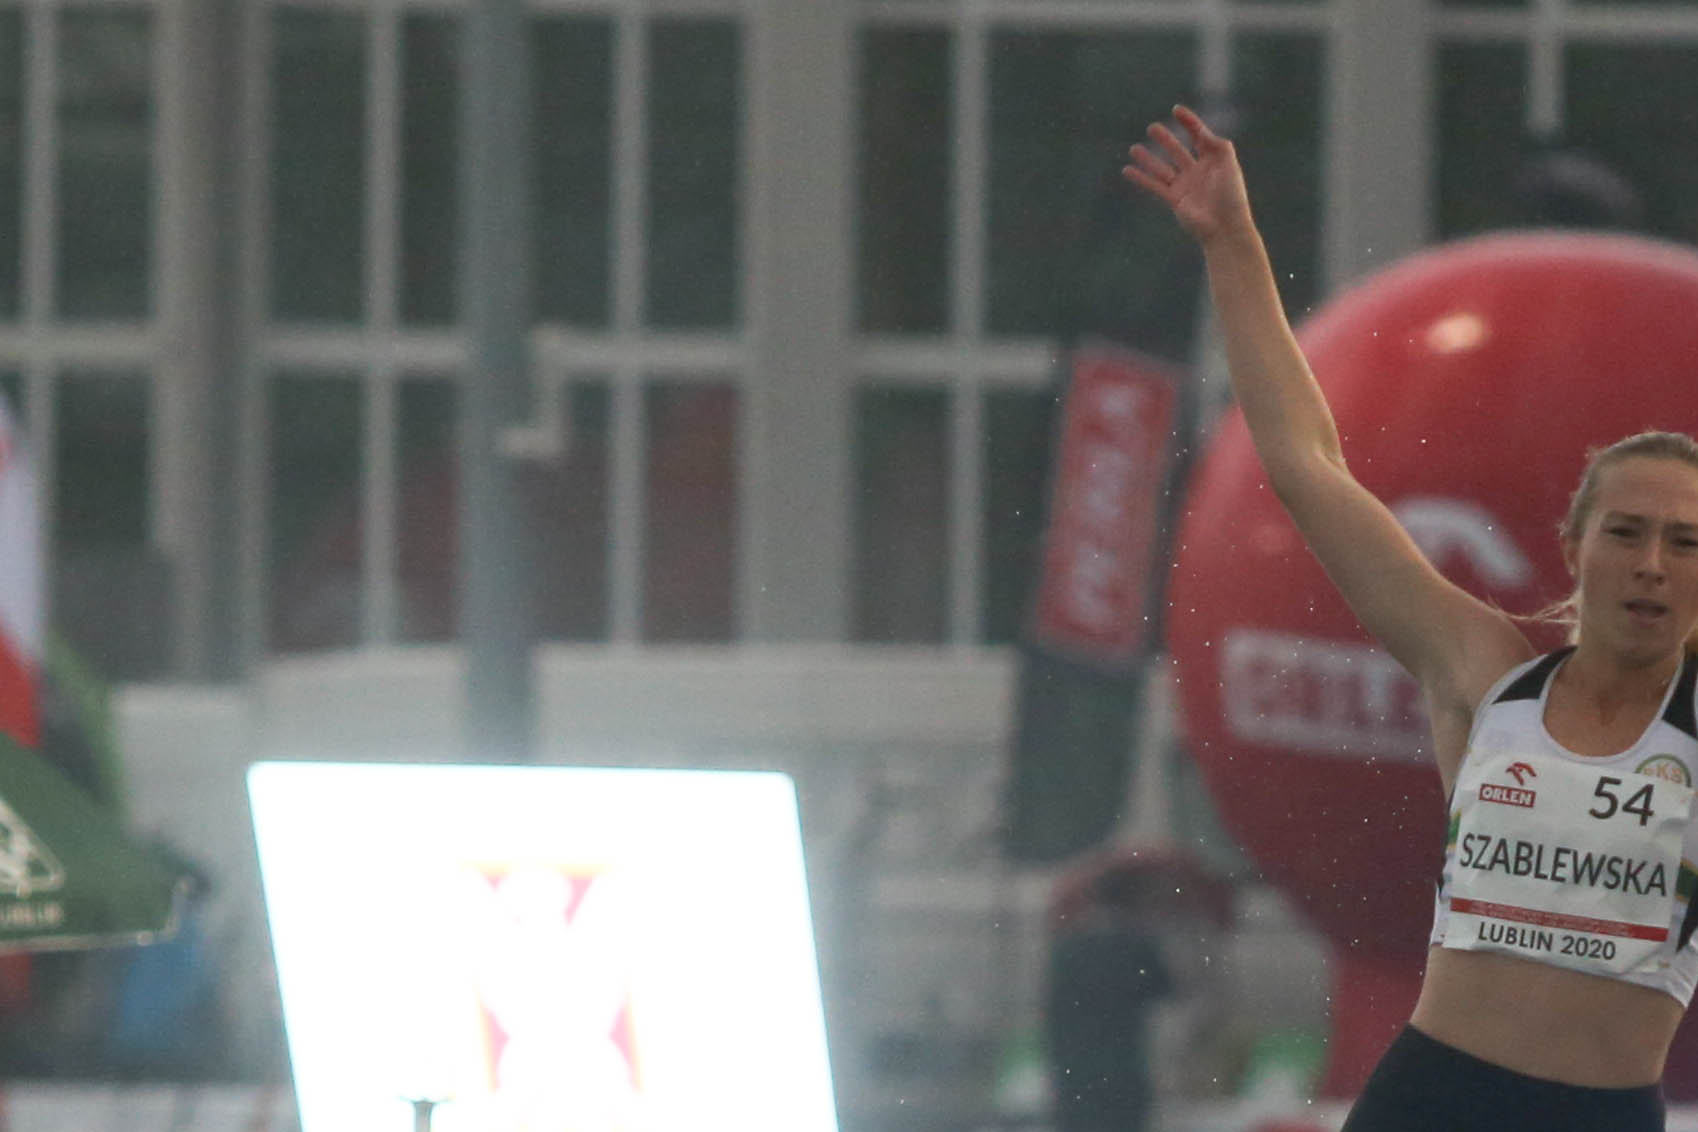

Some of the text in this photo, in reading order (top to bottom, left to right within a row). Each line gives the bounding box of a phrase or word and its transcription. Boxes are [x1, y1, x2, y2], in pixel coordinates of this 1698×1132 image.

[1481, 785, 1532, 806] ORLEN
[1589, 776, 1654, 826] 54
[1460, 832, 1667, 896] SZABLEWSKA
[1478, 921, 1616, 960] LUBLIN 2020
